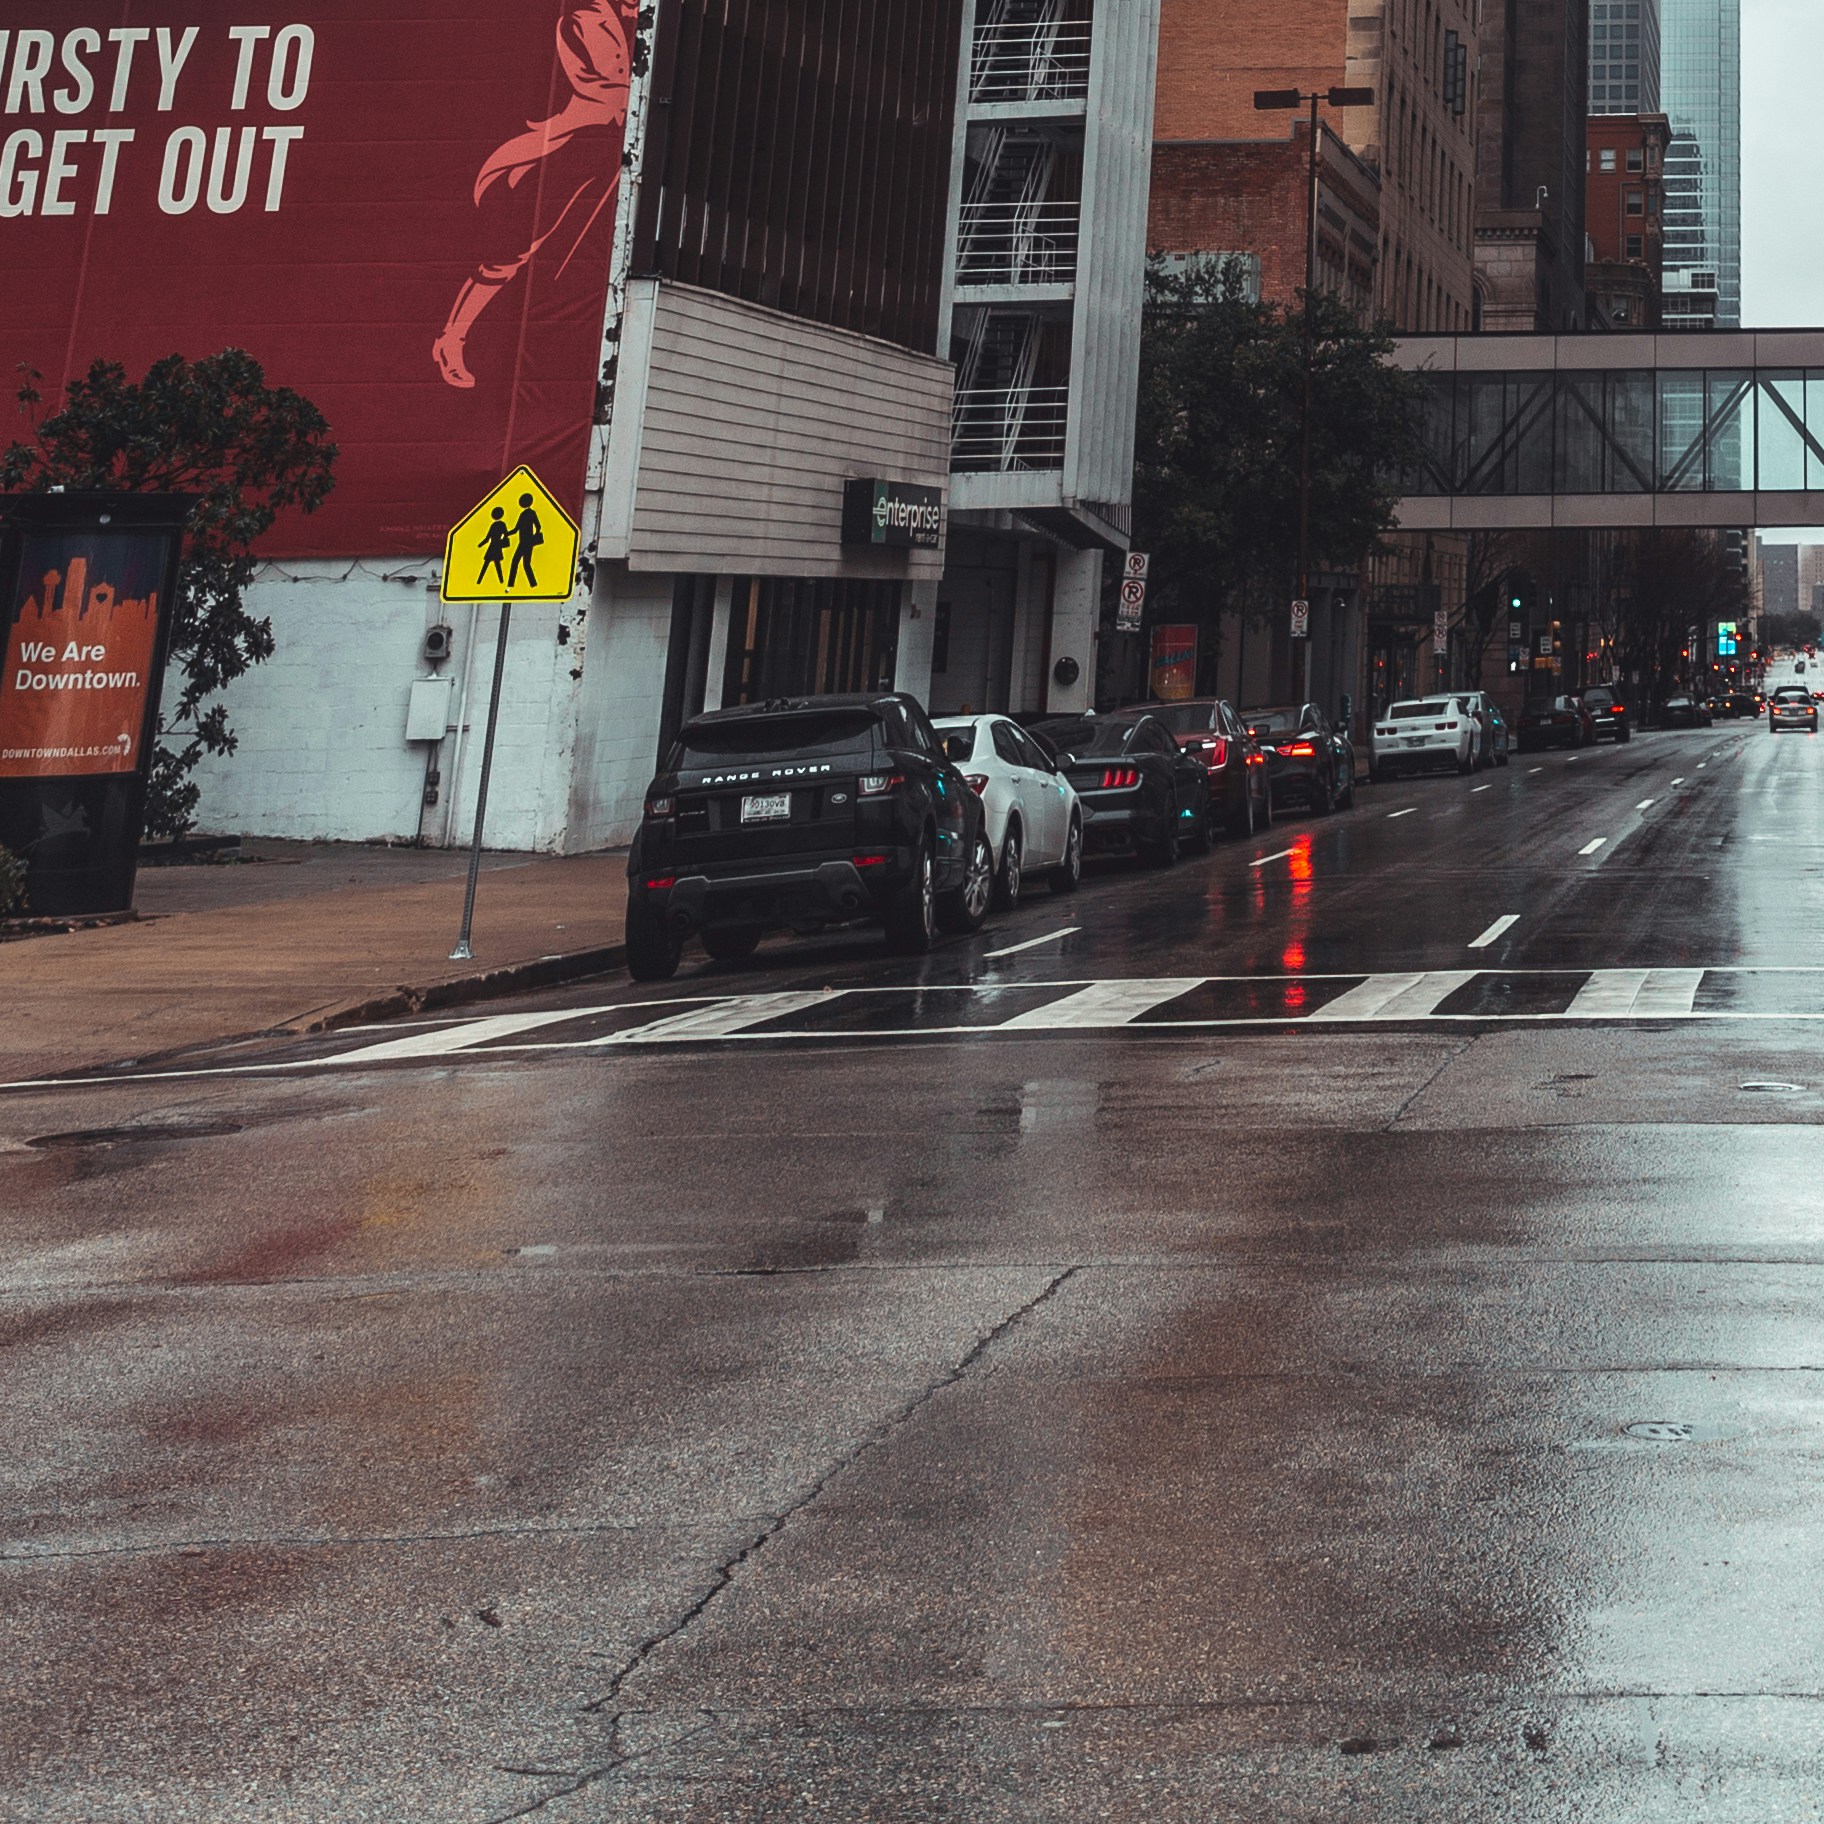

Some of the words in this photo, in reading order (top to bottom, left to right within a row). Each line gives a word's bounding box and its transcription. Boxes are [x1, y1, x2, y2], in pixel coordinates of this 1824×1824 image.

[0, 26, 199, 114] RSTY
[228, 23, 315, 111] TO
[0, 128, 136, 218] GET
[158, 125, 304, 215] OUT
[873, 497, 939, 537] enterprise
[21, 641, 56, 663] We
[61, 641, 106, 662] Are
[15, 669, 141, 690] Downtown.
[702, 772, 760, 784] RANGE
[772, 765, 831, 777] ROVER
